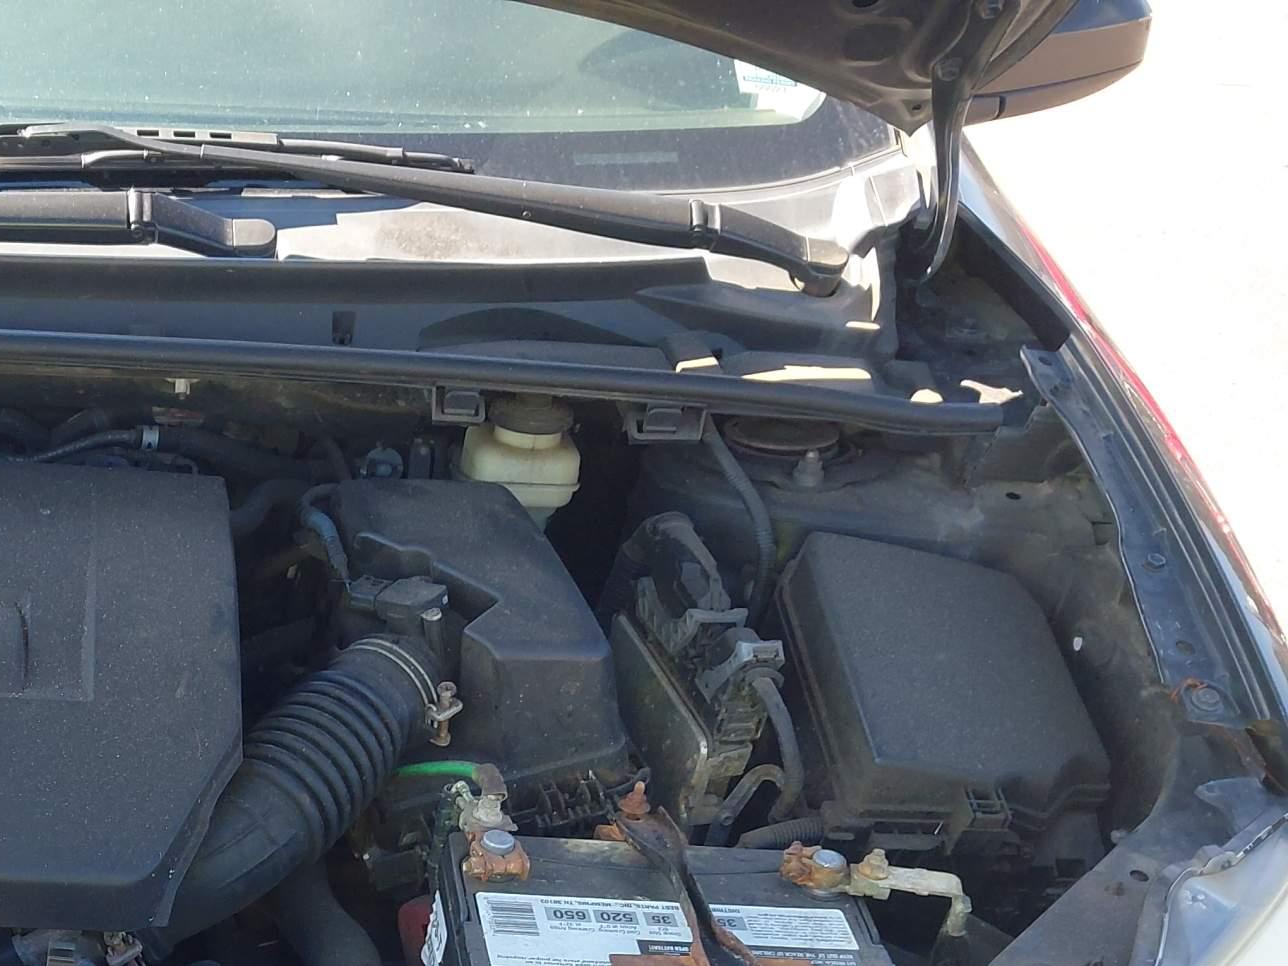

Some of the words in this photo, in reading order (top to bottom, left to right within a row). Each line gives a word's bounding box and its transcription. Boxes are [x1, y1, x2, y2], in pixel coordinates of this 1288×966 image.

[553, 909, 586, 921] 650
[600, 911, 633, 922] 520
[651, 915, 672, 925] 35
[717, 918, 737, 928] 35
